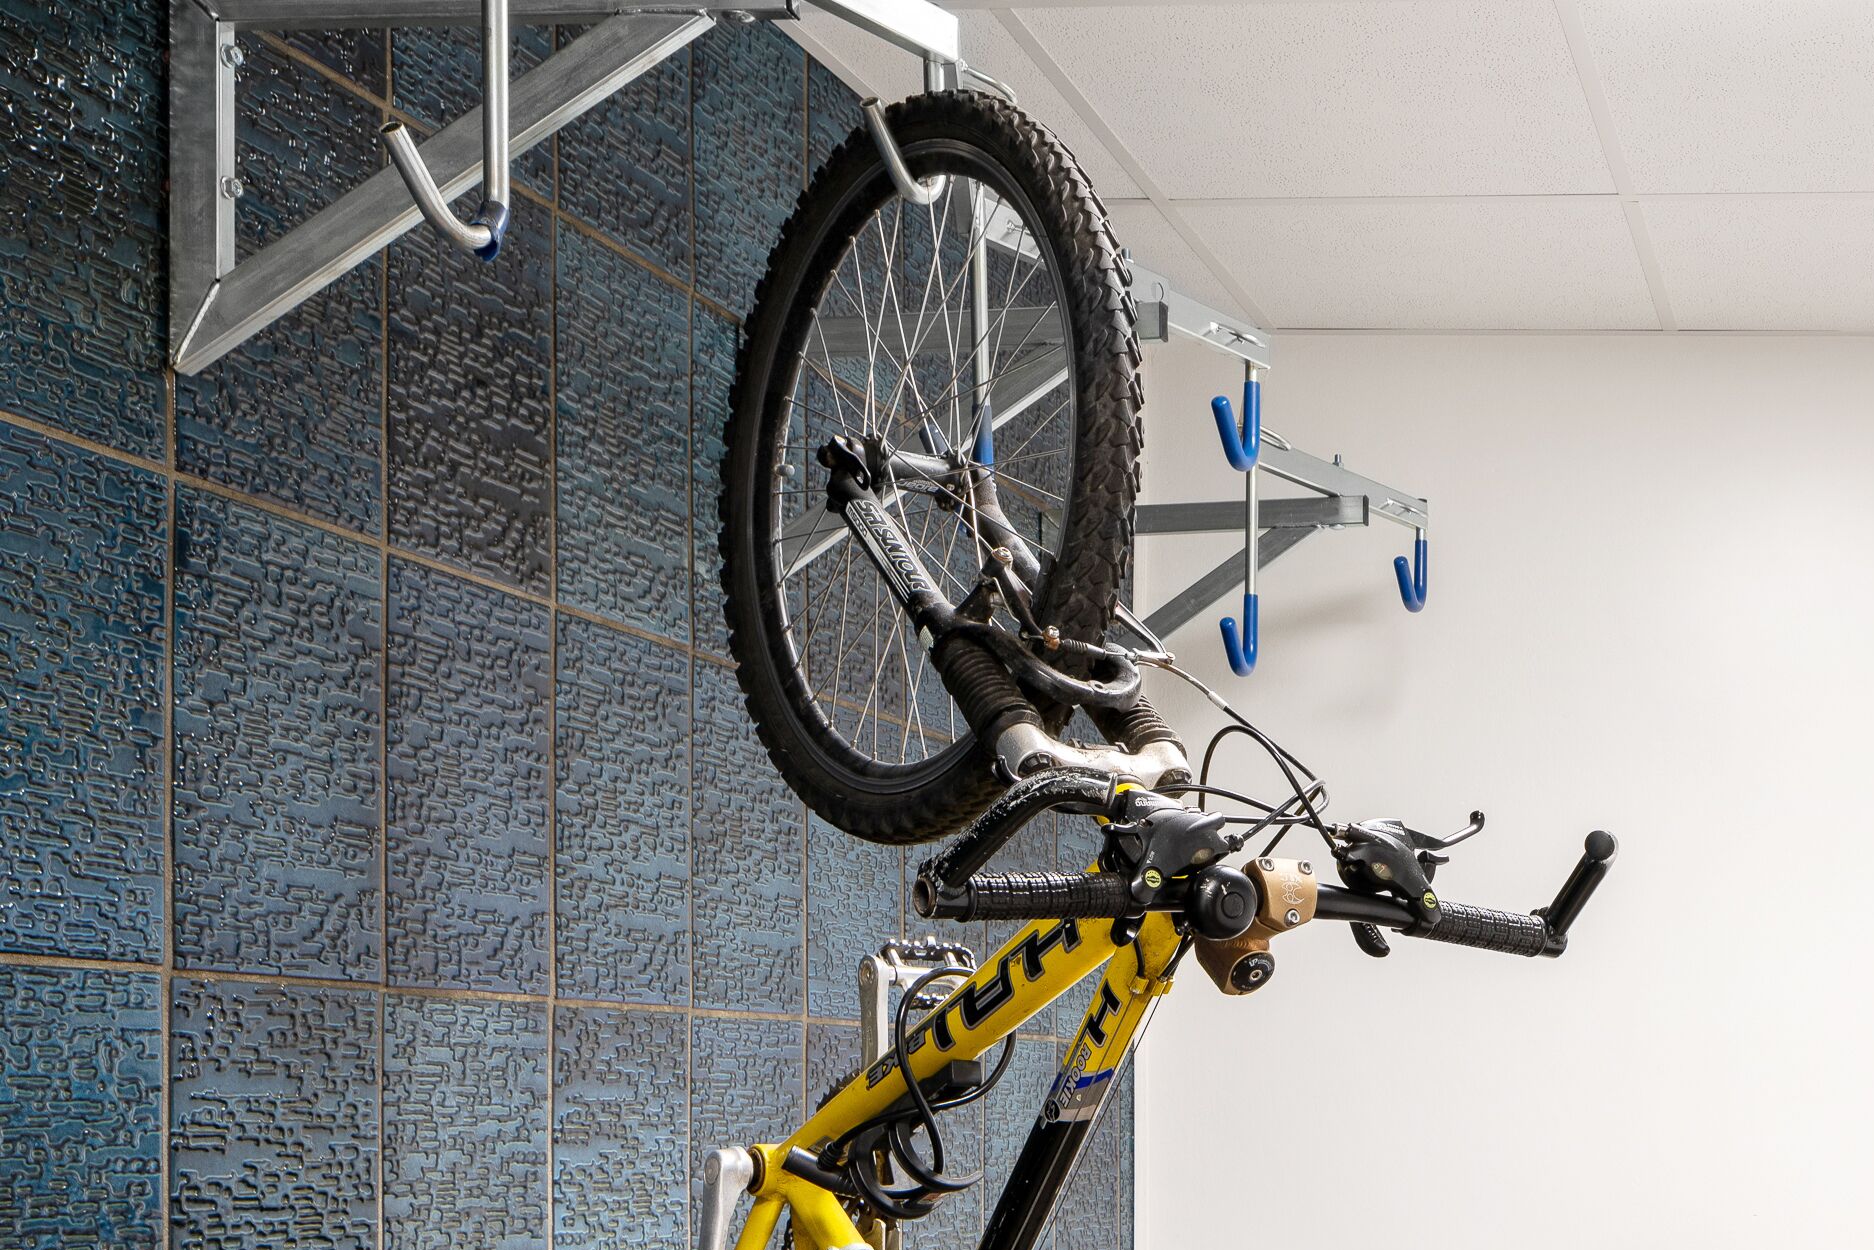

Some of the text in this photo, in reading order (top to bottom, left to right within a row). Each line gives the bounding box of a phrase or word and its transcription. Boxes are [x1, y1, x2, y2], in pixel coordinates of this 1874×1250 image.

[873, 527, 931, 591] SUNTOUR
[867, 918, 1081, 1089] HAI BKE
[1059, 1043, 1092, 1108] ROOKIE
